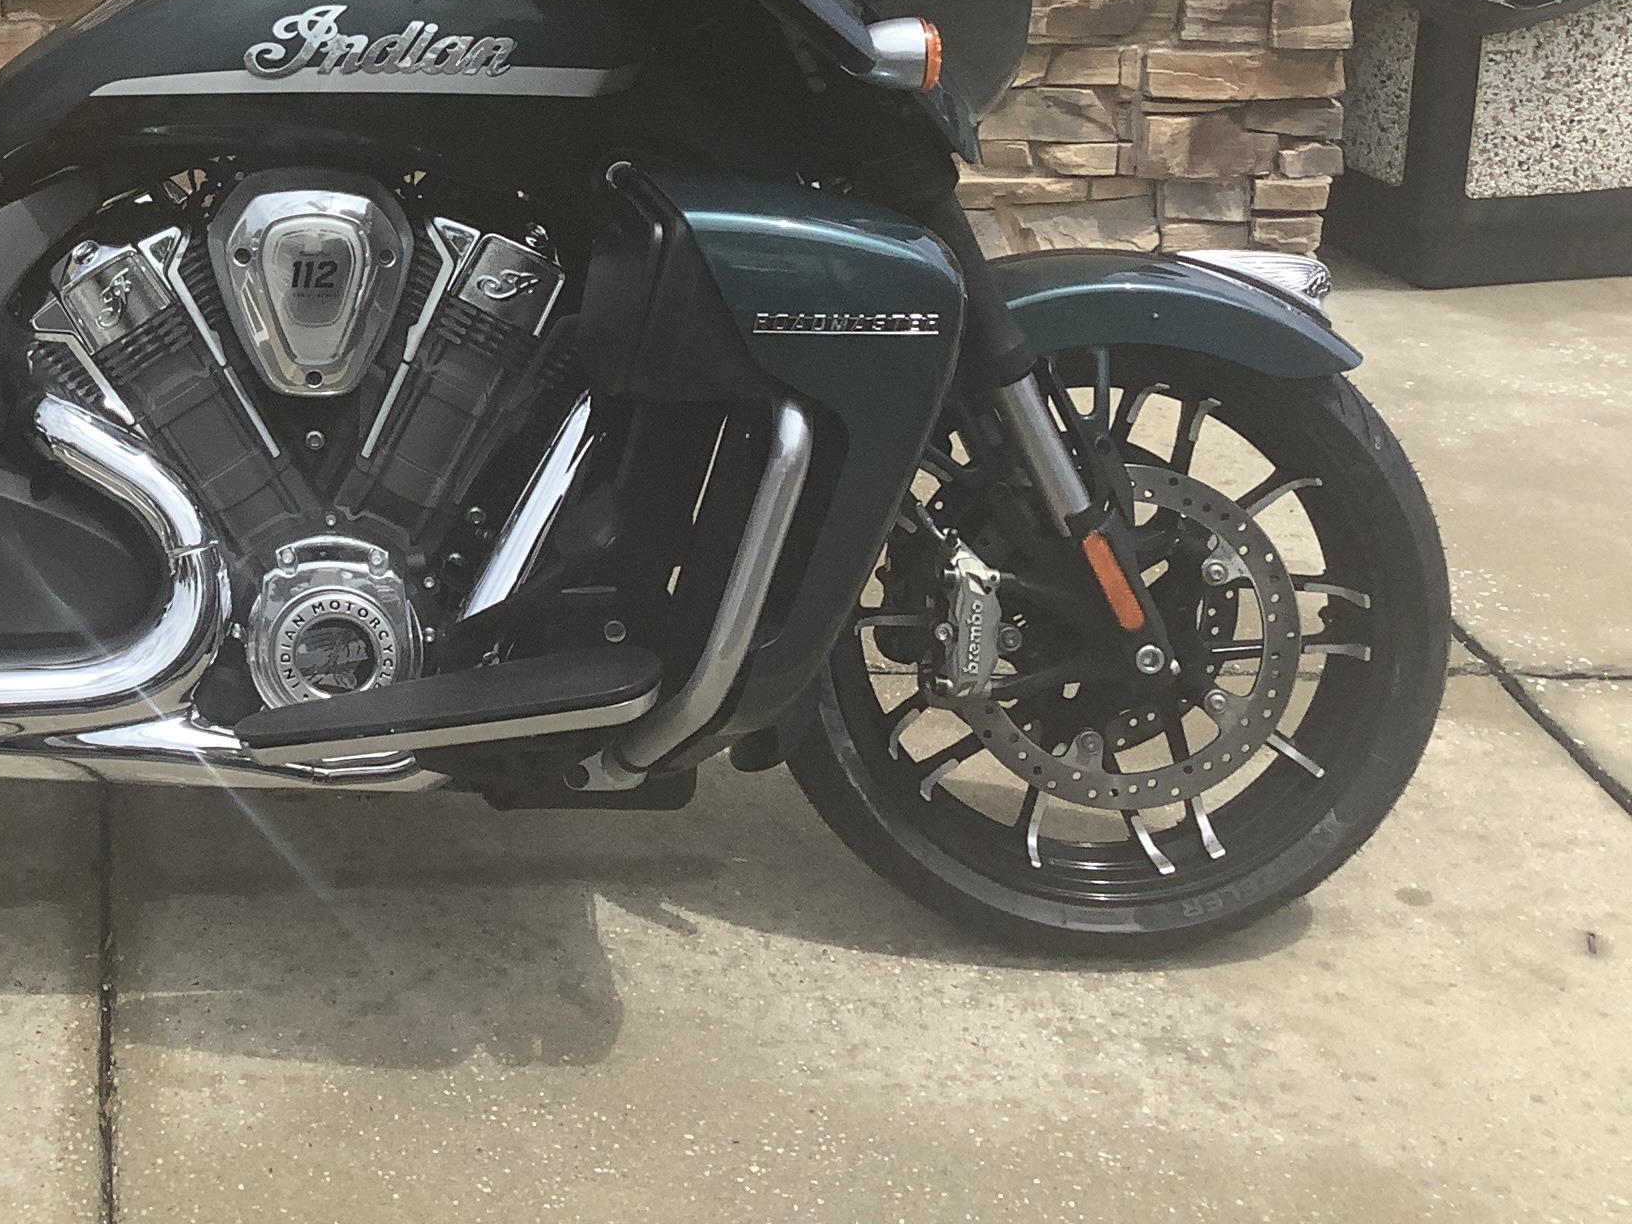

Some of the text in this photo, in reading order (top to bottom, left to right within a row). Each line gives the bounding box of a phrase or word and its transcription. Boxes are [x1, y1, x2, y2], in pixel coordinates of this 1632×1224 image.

[244, 4, 518, 80] Indian
[291, 260, 339, 289] 112
[753, 312, 940, 332] ROADMASTER
[280, 613, 306, 689] INDIAN
[962, 599, 984, 674] brembo
